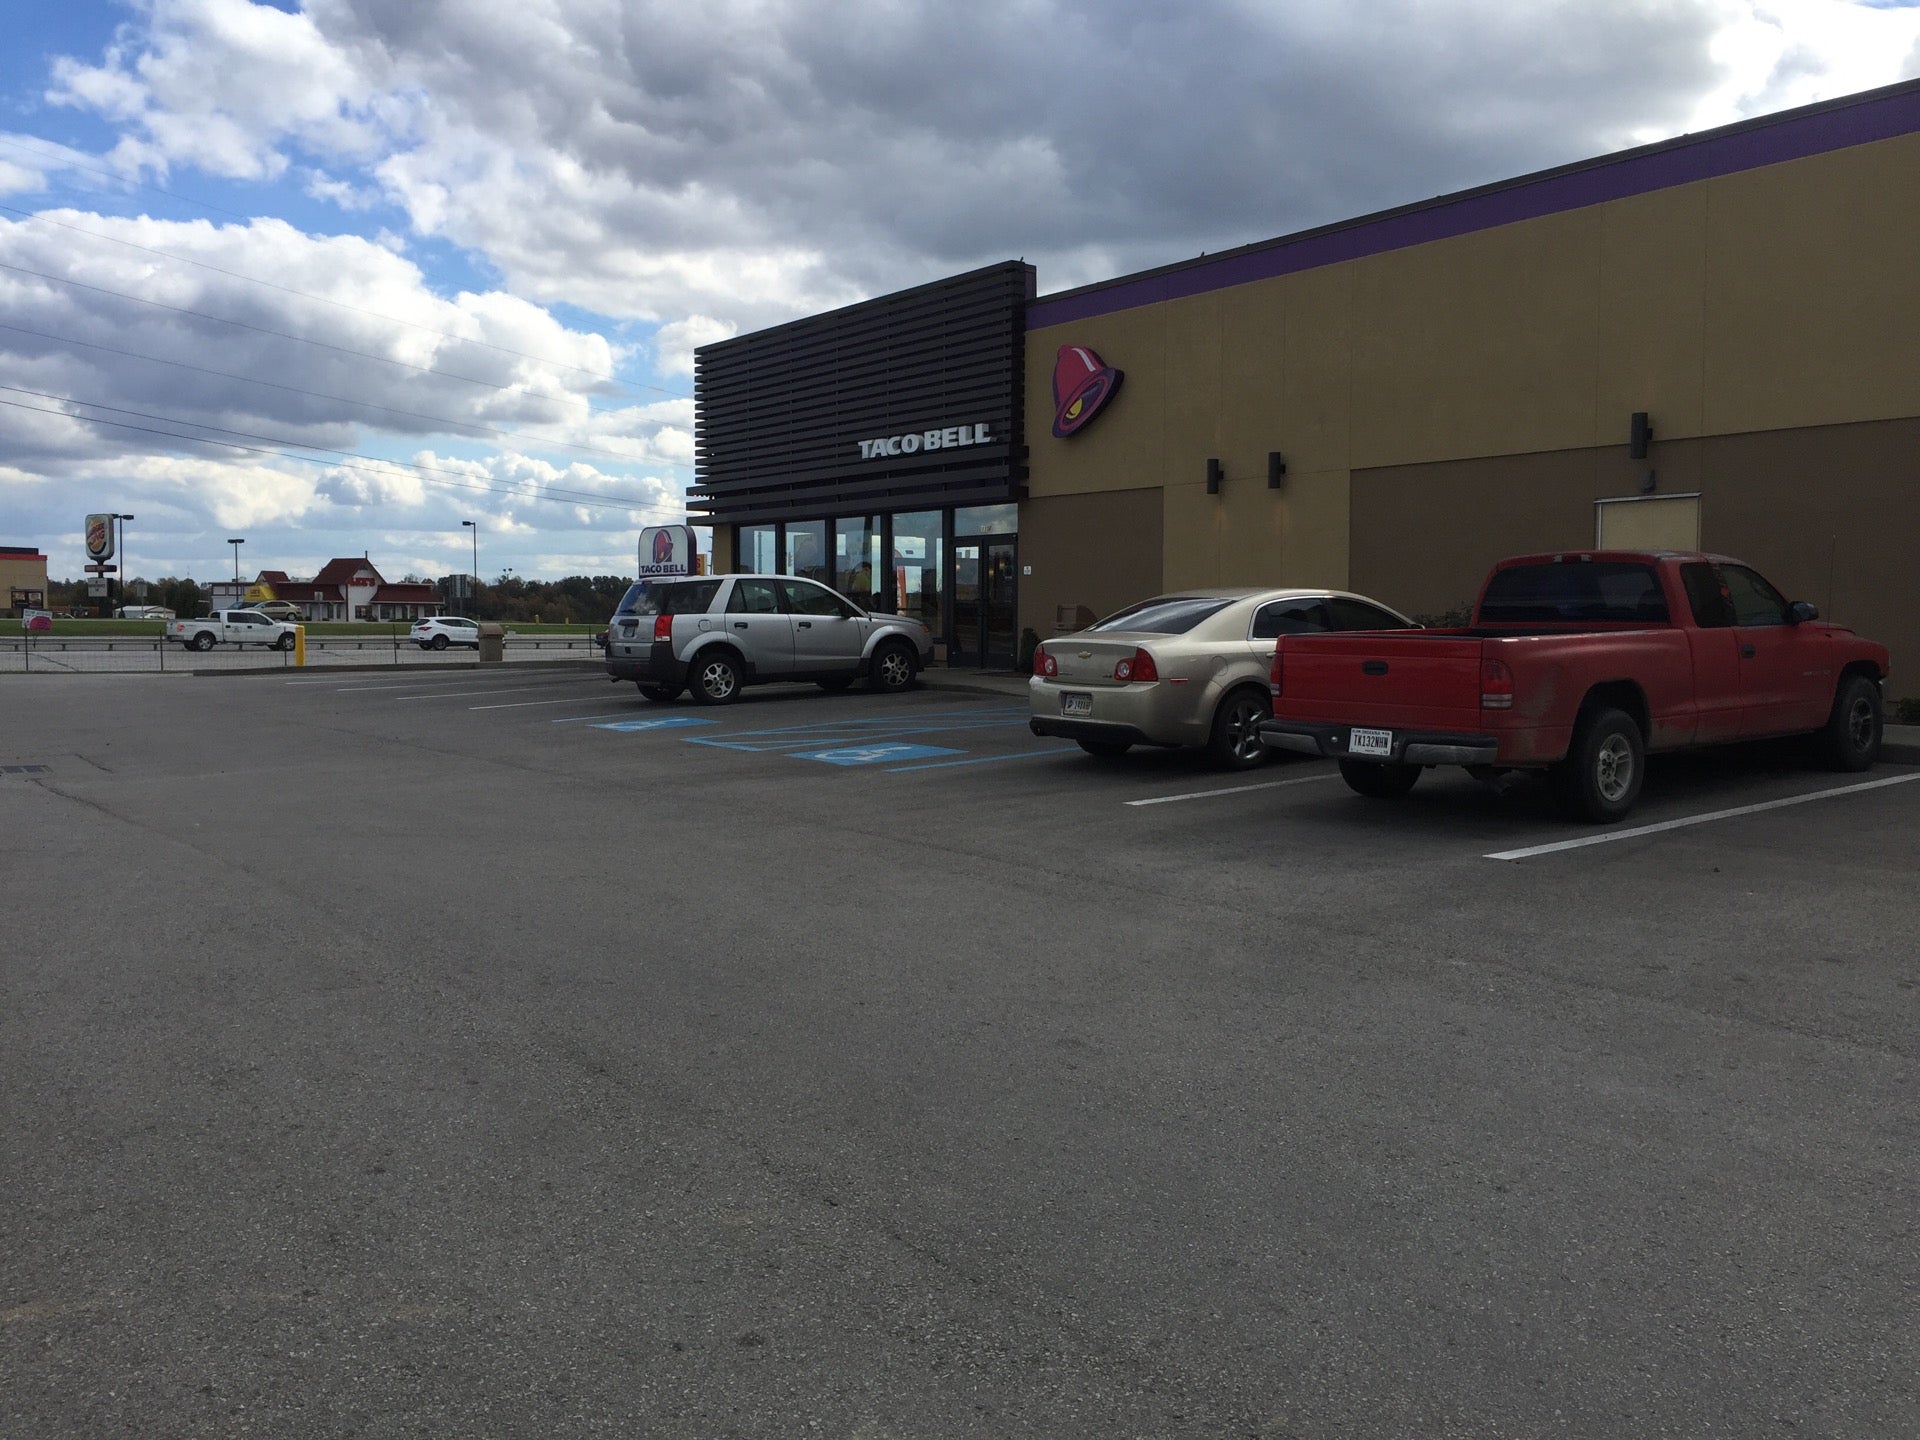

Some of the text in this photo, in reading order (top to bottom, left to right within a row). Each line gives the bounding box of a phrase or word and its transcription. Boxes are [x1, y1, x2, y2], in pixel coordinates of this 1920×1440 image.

[858, 423, 991, 459] TACO BELL
[641, 564, 687, 574] TACO BELL
